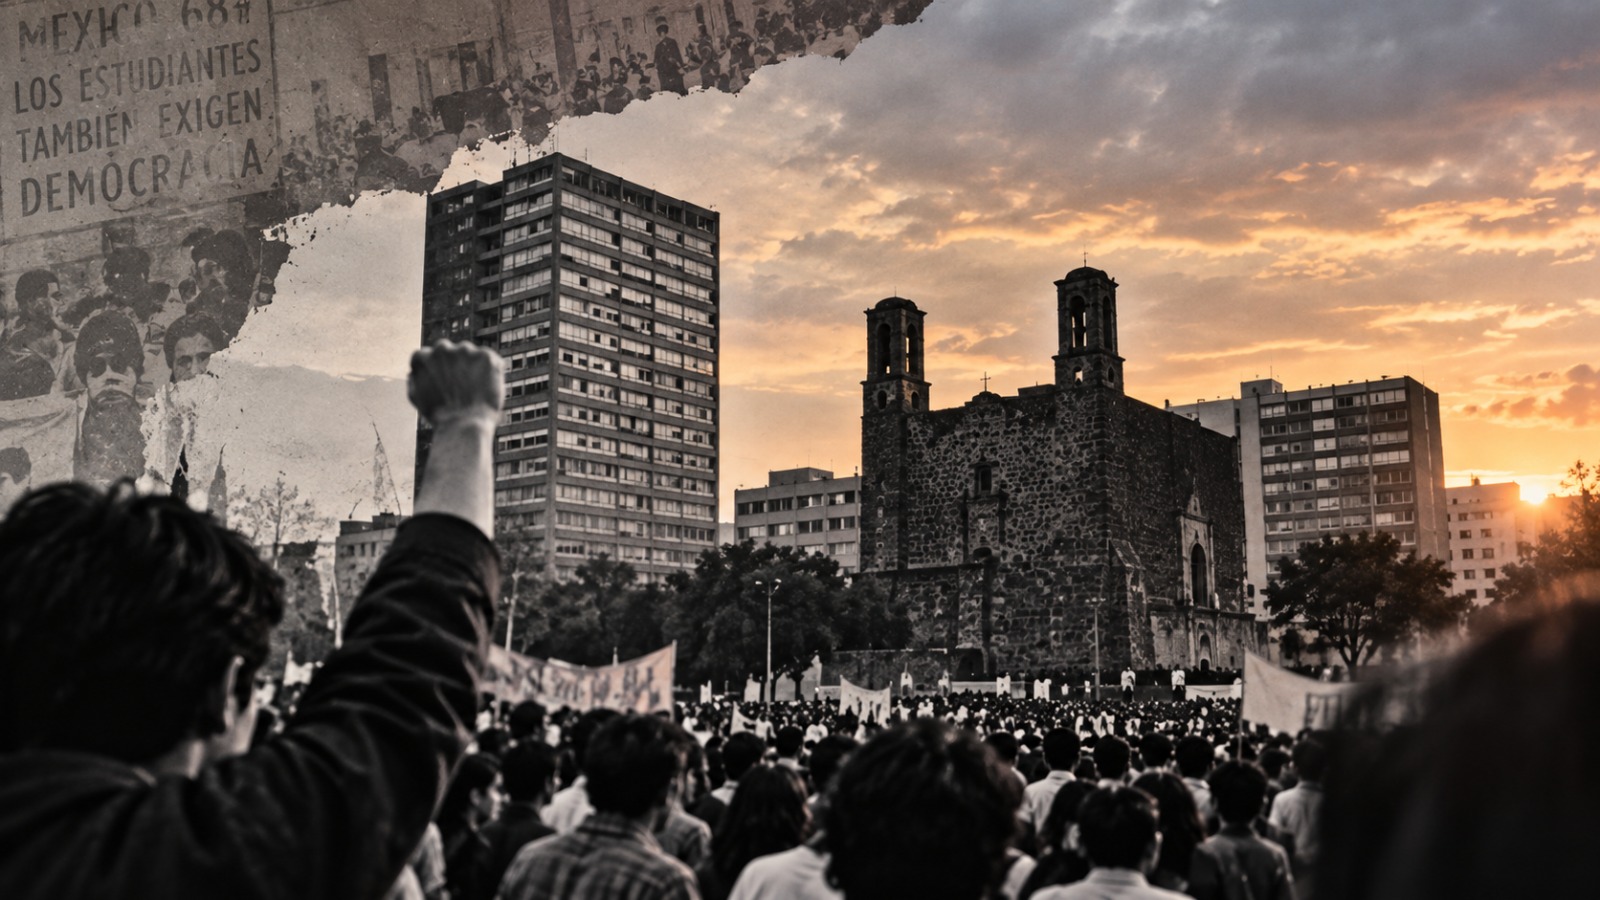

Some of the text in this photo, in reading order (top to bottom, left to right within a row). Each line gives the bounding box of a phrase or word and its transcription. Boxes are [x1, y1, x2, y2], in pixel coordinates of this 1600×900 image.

[14, 38, 262, 115] LOS ESTUDIANTES
[158, 86, 263, 140] EXIGEN
